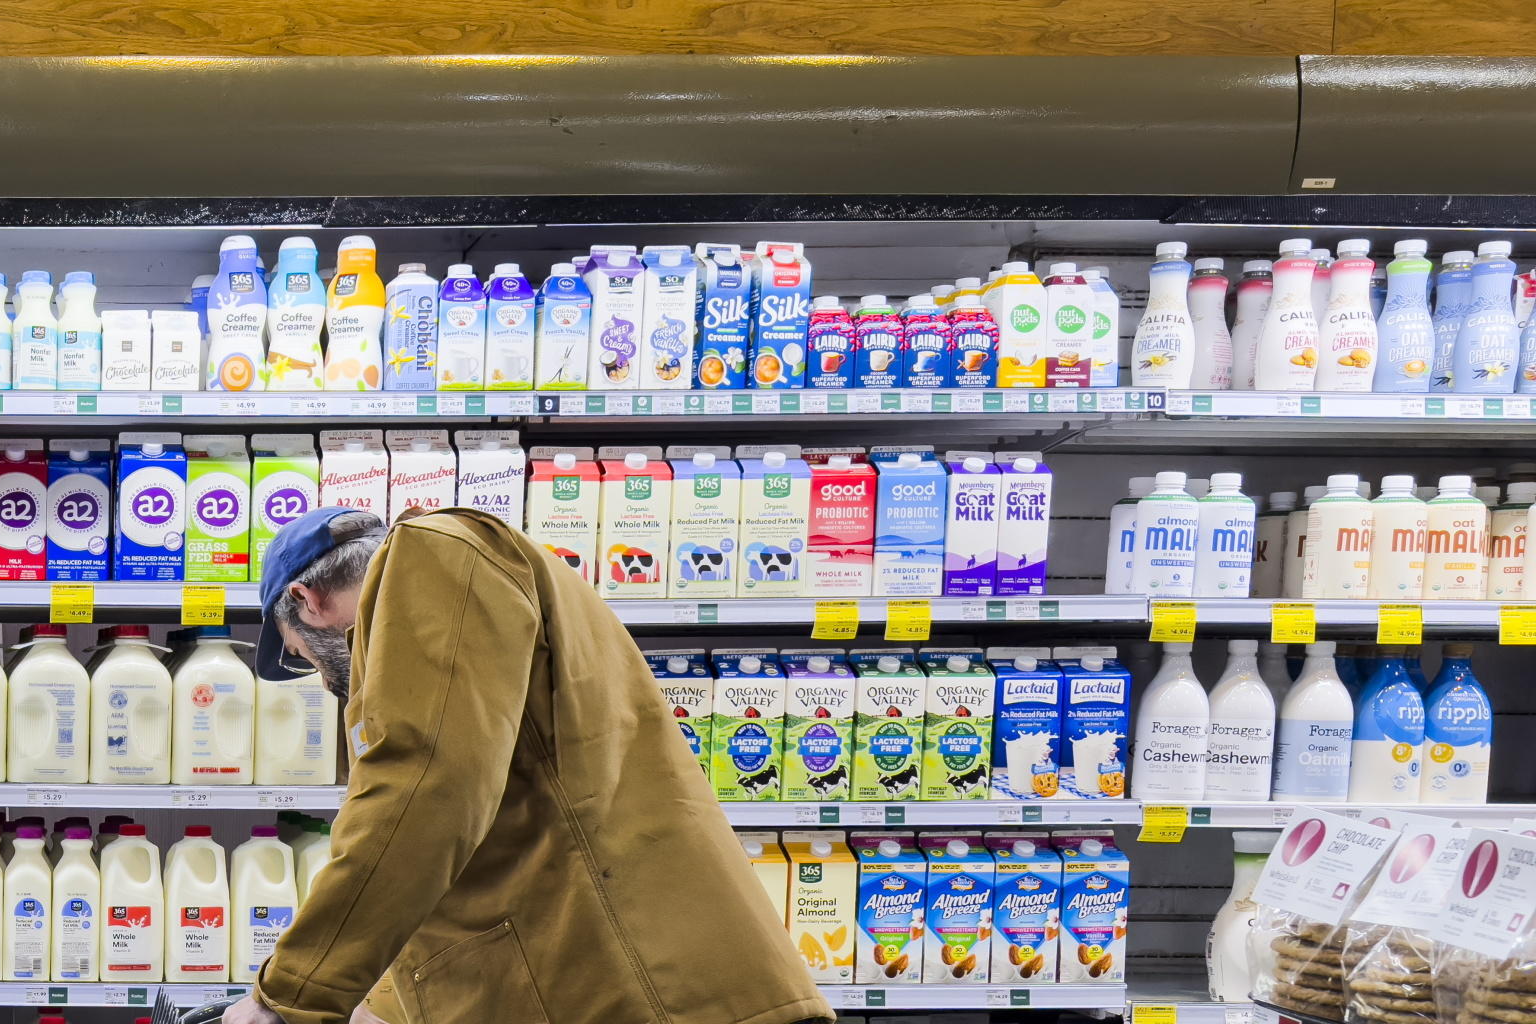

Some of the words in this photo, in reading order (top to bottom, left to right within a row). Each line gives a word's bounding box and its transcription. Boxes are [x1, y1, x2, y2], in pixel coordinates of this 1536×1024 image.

[232, 274, 252, 284] 365
[288, 274, 309, 284] 365
[226, 314, 258, 322] Coffee
[281, 314, 313, 322] Coffee
[704, 296, 748, 330] Silk
[1057, 308, 1076, 317] nut
[1057, 316, 1084, 326] pods
[222, 323, 260, 332] Creamer
[277, 323, 315, 332] Creamer
[416, 295, 431, 372] Chobani
[816, 335, 847, 350] LAIRD
[864, 334, 895, 349] LAIRD
[911, 335, 943, 350] LAIRD
[1137, 338, 1180, 353] CREAMER
[105, 366, 149, 379] Chocolate
[544, 398, 553, 410] 9
[1148, 395, 1162, 406] 10
[322, 467, 387, 486] Alexandre
[459, 466, 523, 486] Alexandre
[555, 479, 577, 492] 365
[767, 477, 788, 490] 365
[822, 481, 866, 500] good
[137, 493, 170, 516] a2
[472, 495, 509, 507] A2/A2
[955, 492, 995, 507] Goat
[202, 497, 234, 520] a2
[816, 507, 868, 518] PROBIOTIC
[955, 507, 993, 521] Milk
[570, 520, 588, 528] Milk
[188, 542, 227, 552] GRASS
[189, 553, 212, 562] FED
[1007, 683, 1054, 696] Lactaid
[1152, 722, 1200, 736] Forager
[732, 739, 768, 747] LACTOSE
[1151, 742, 1182, 750] Organic
[739, 746, 760, 754] FREE
[1337, 828, 1386, 850] CHOCOLATE
[1327, 842, 1349, 854] CHIP
[797, 898, 837, 908] Original
[865, 890, 920, 910] Almond
[797, 908, 836, 917] Almond
[875, 904, 912, 918] Breeze
